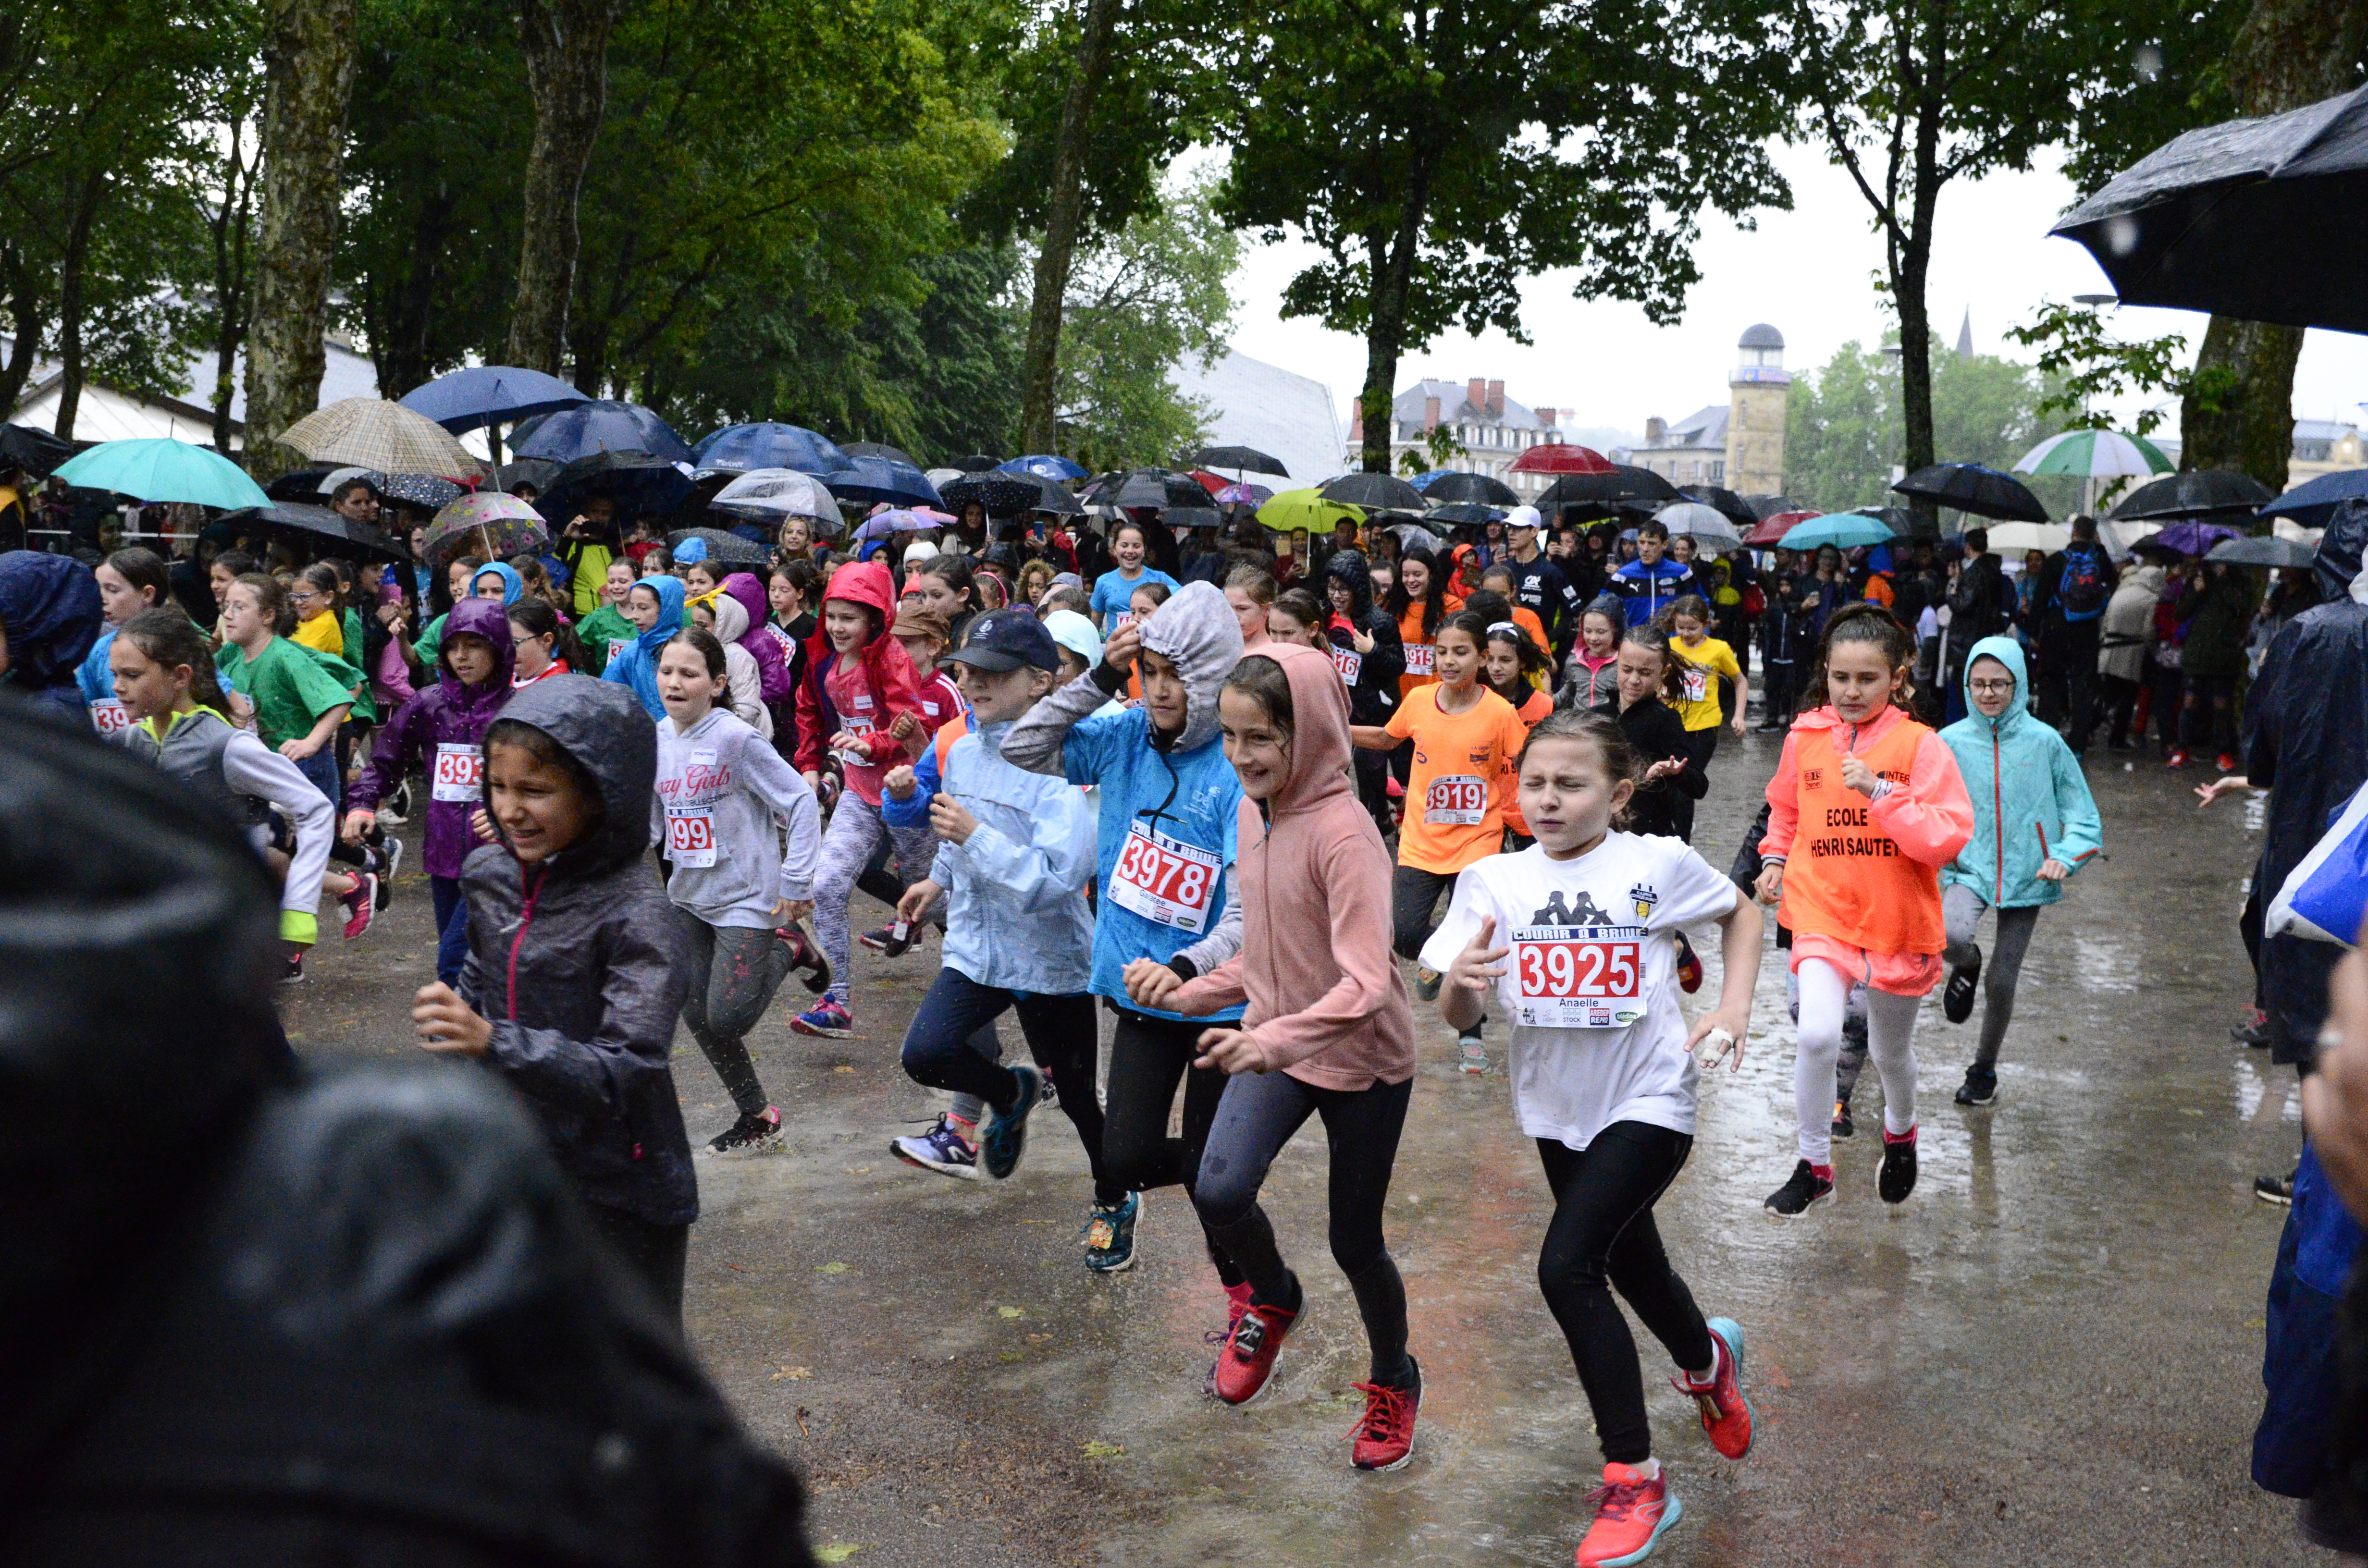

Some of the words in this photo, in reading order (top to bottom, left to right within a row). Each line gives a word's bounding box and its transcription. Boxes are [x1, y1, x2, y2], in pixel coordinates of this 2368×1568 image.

[685, 764, 730, 798] Girls
[1426, 784, 1480, 812] 3919
[1827, 808, 1868, 827] ECOLE
[1811, 837, 1845, 858] HENRI
[1121, 839, 1206, 906] 3978
[1514, 929, 1570, 940] COURIR
[1597, 928, 1648, 938] BRIVE
[1521, 945, 1635, 996] 3925
[1559, 998, 1599, 1007] Anaelle
